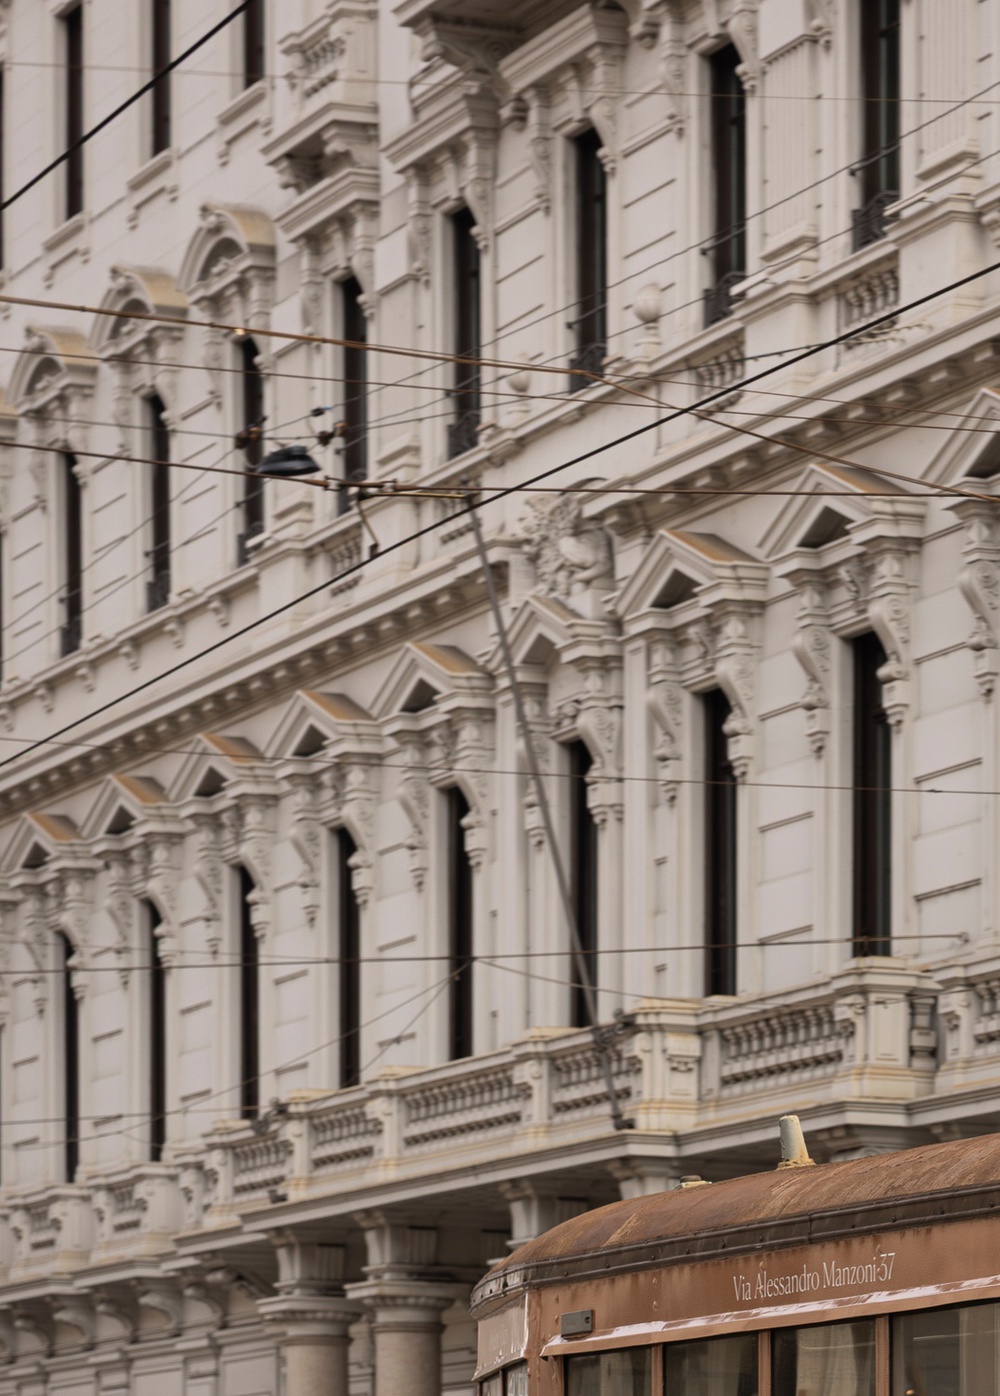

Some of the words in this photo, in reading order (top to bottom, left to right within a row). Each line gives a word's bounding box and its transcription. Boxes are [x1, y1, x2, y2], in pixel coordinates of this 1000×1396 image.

[733, 1275, 752, 1302] Via
[754, 1264, 820, 1299] Alessandro
[822, 1256, 877, 1289] Manzoni
[878, 1252, 896, 1282] 37
